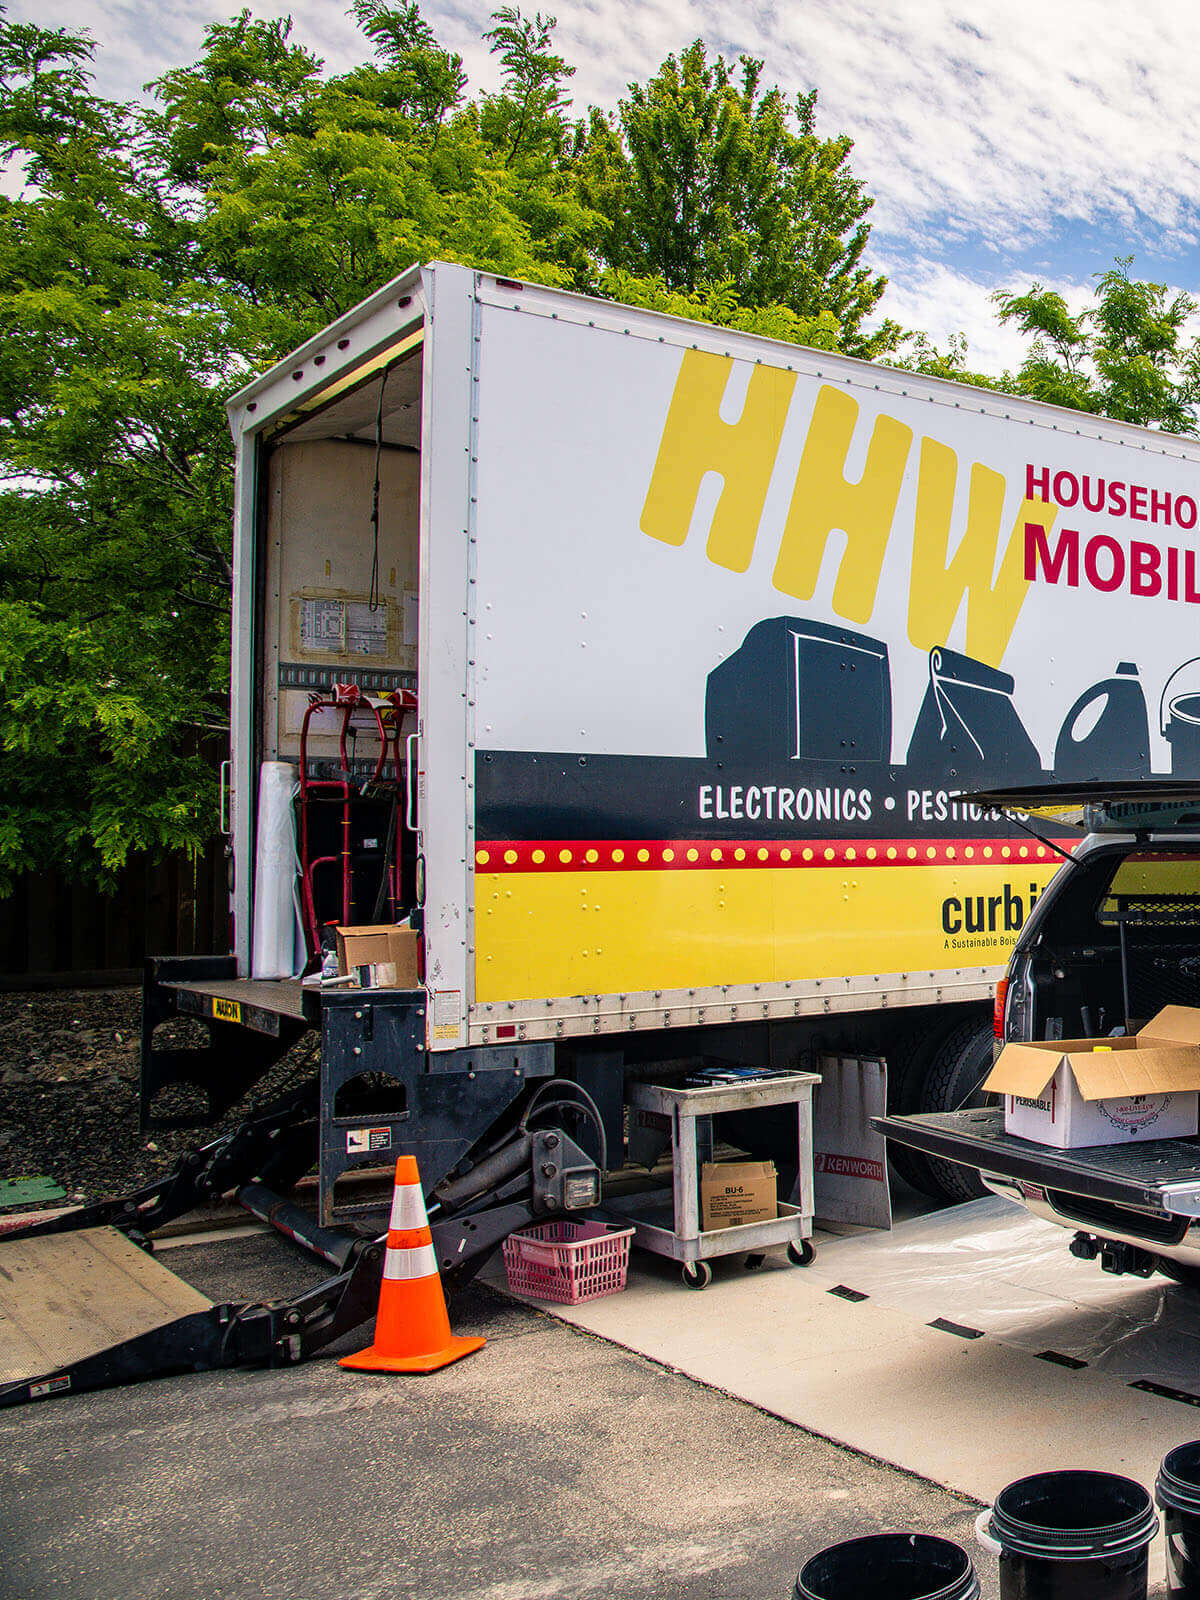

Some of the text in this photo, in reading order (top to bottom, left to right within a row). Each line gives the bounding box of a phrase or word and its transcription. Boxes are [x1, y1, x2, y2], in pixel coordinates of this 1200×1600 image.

[639, 347, 1059, 669] HHW
[699, 785, 872, 821] ELECTRONICS
[944, 940, 949, 949] A
[951, 938, 997, 949] Sustainable
[1015, 1095, 1051, 1112] PERISHABLE
[827, 1157, 883, 1178] KENWORTH
[725, 1185, 744, 1195] BU-6
